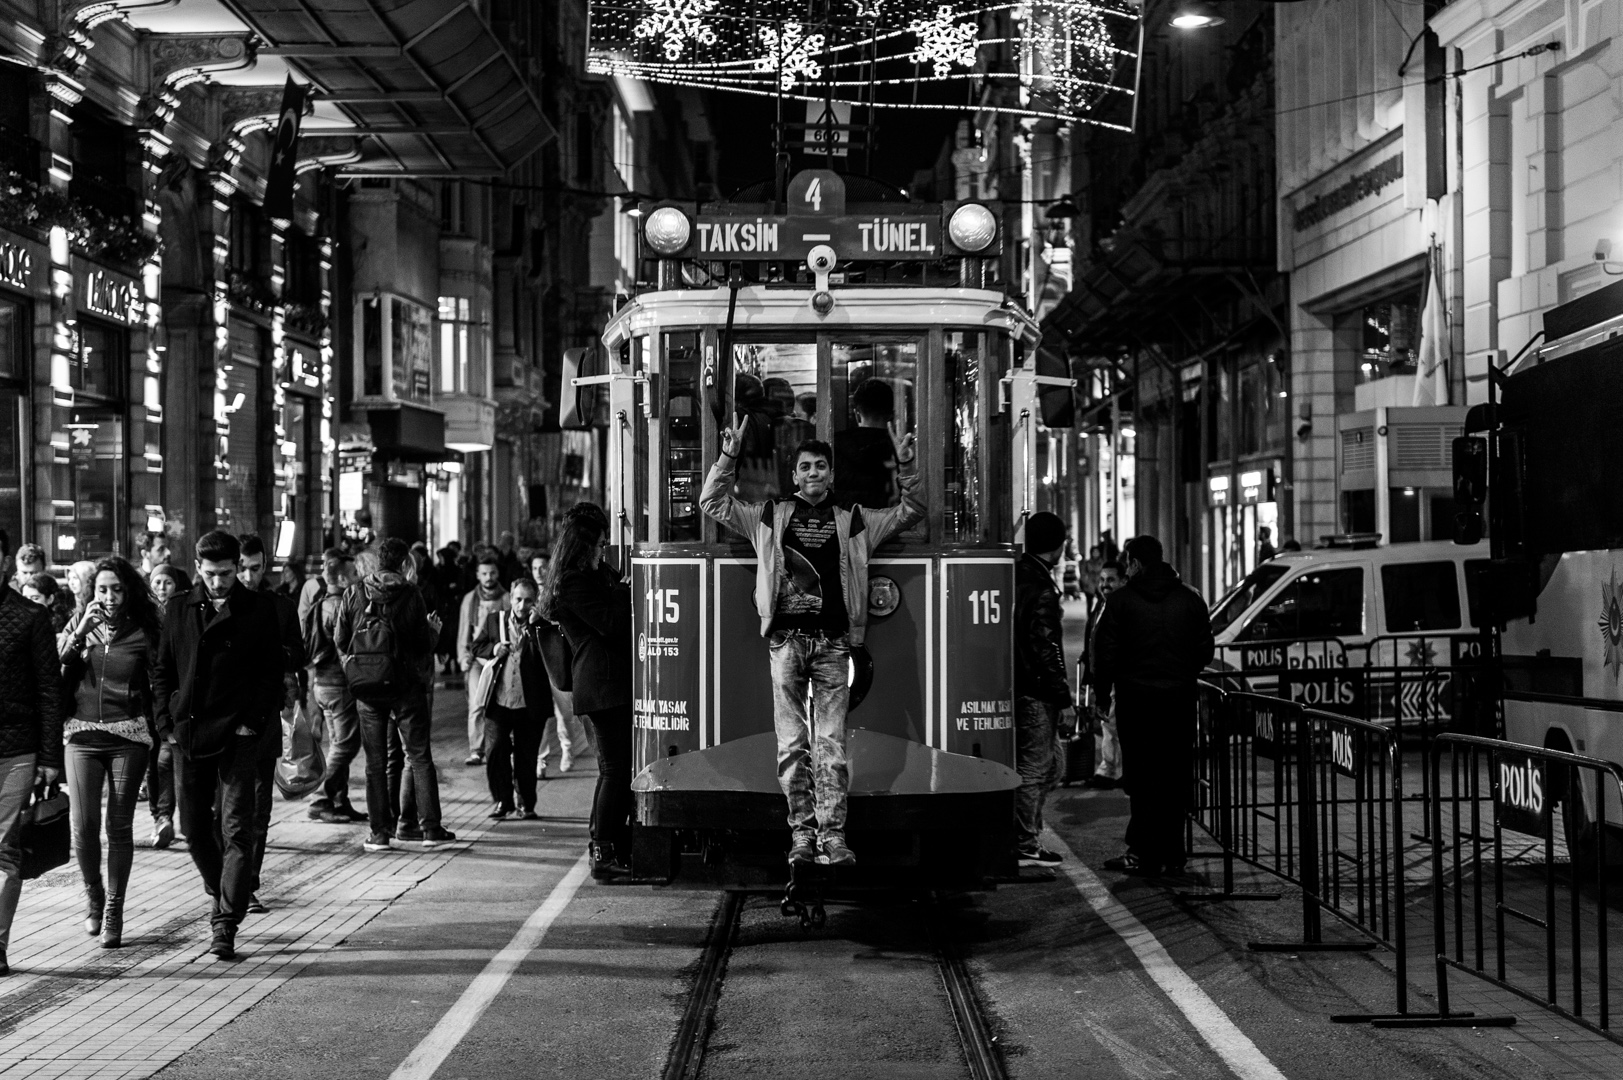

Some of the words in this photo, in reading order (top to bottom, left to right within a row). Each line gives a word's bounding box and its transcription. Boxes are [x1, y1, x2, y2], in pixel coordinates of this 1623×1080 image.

[805, 177, 822, 211] 4
[697, 217, 778, 252] TAKSİM
[858, 217, 935, 255] TÜNEL
[646, 589, 680, 624] 115
[968, 590, 1001, 625] 115
[647, 646, 662, 657] ALO
[663, 646, 679, 657] 153
[1247, 646, 1283, 667] POLİS
[658, 700, 687, 714] YASAK
[1290, 676, 1355, 705] POLİS
[956, 717, 970, 731] VE
[1255, 707, 1274, 742] POLİS
[1332, 727, 1353, 771] POLİS
[1500, 757, 1543, 814] POLİS
